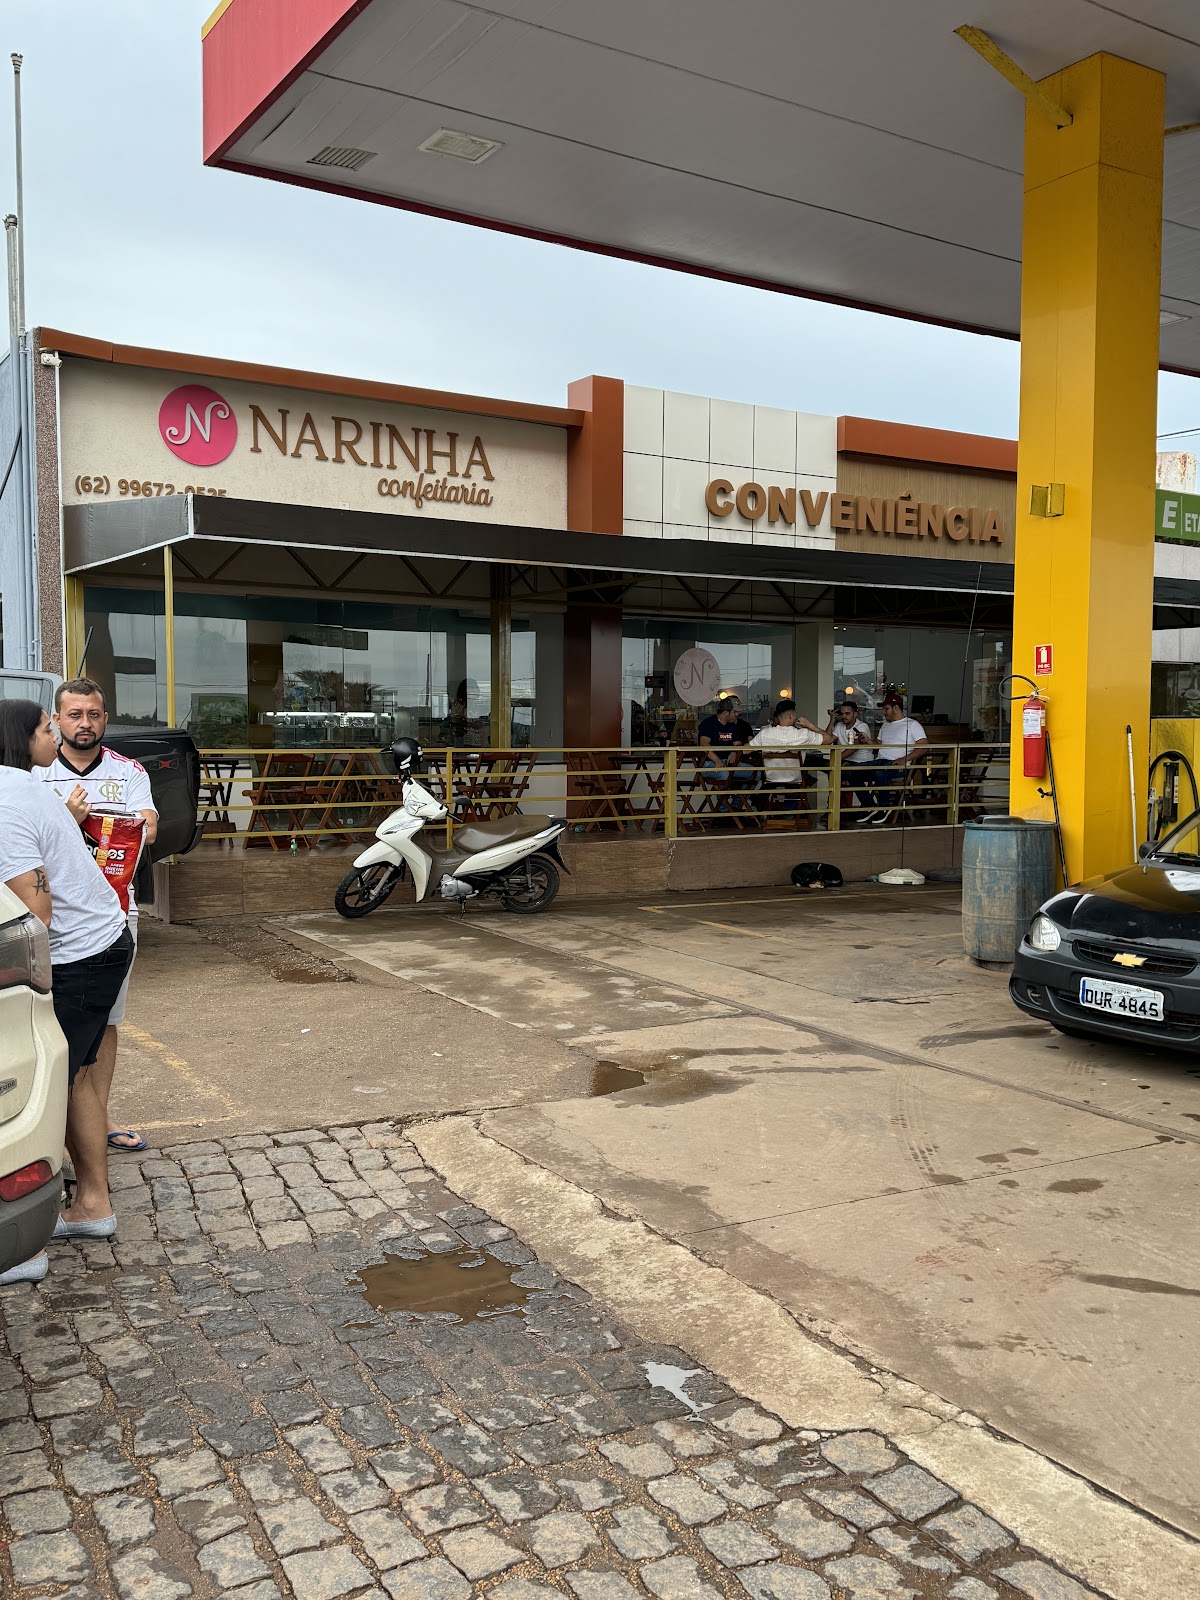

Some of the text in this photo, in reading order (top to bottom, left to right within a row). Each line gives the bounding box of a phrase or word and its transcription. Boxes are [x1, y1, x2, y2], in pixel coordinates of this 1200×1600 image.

[166, 401, 230, 446] N
[248, 404, 495, 481] NARINHA
[75, 475, 111, 495] (62)
[377, 472, 494, 509] confeitaria
[705, 478, 1005, 543] CONVENIÊNCIA
[1162, 500, 1178, 529] E
